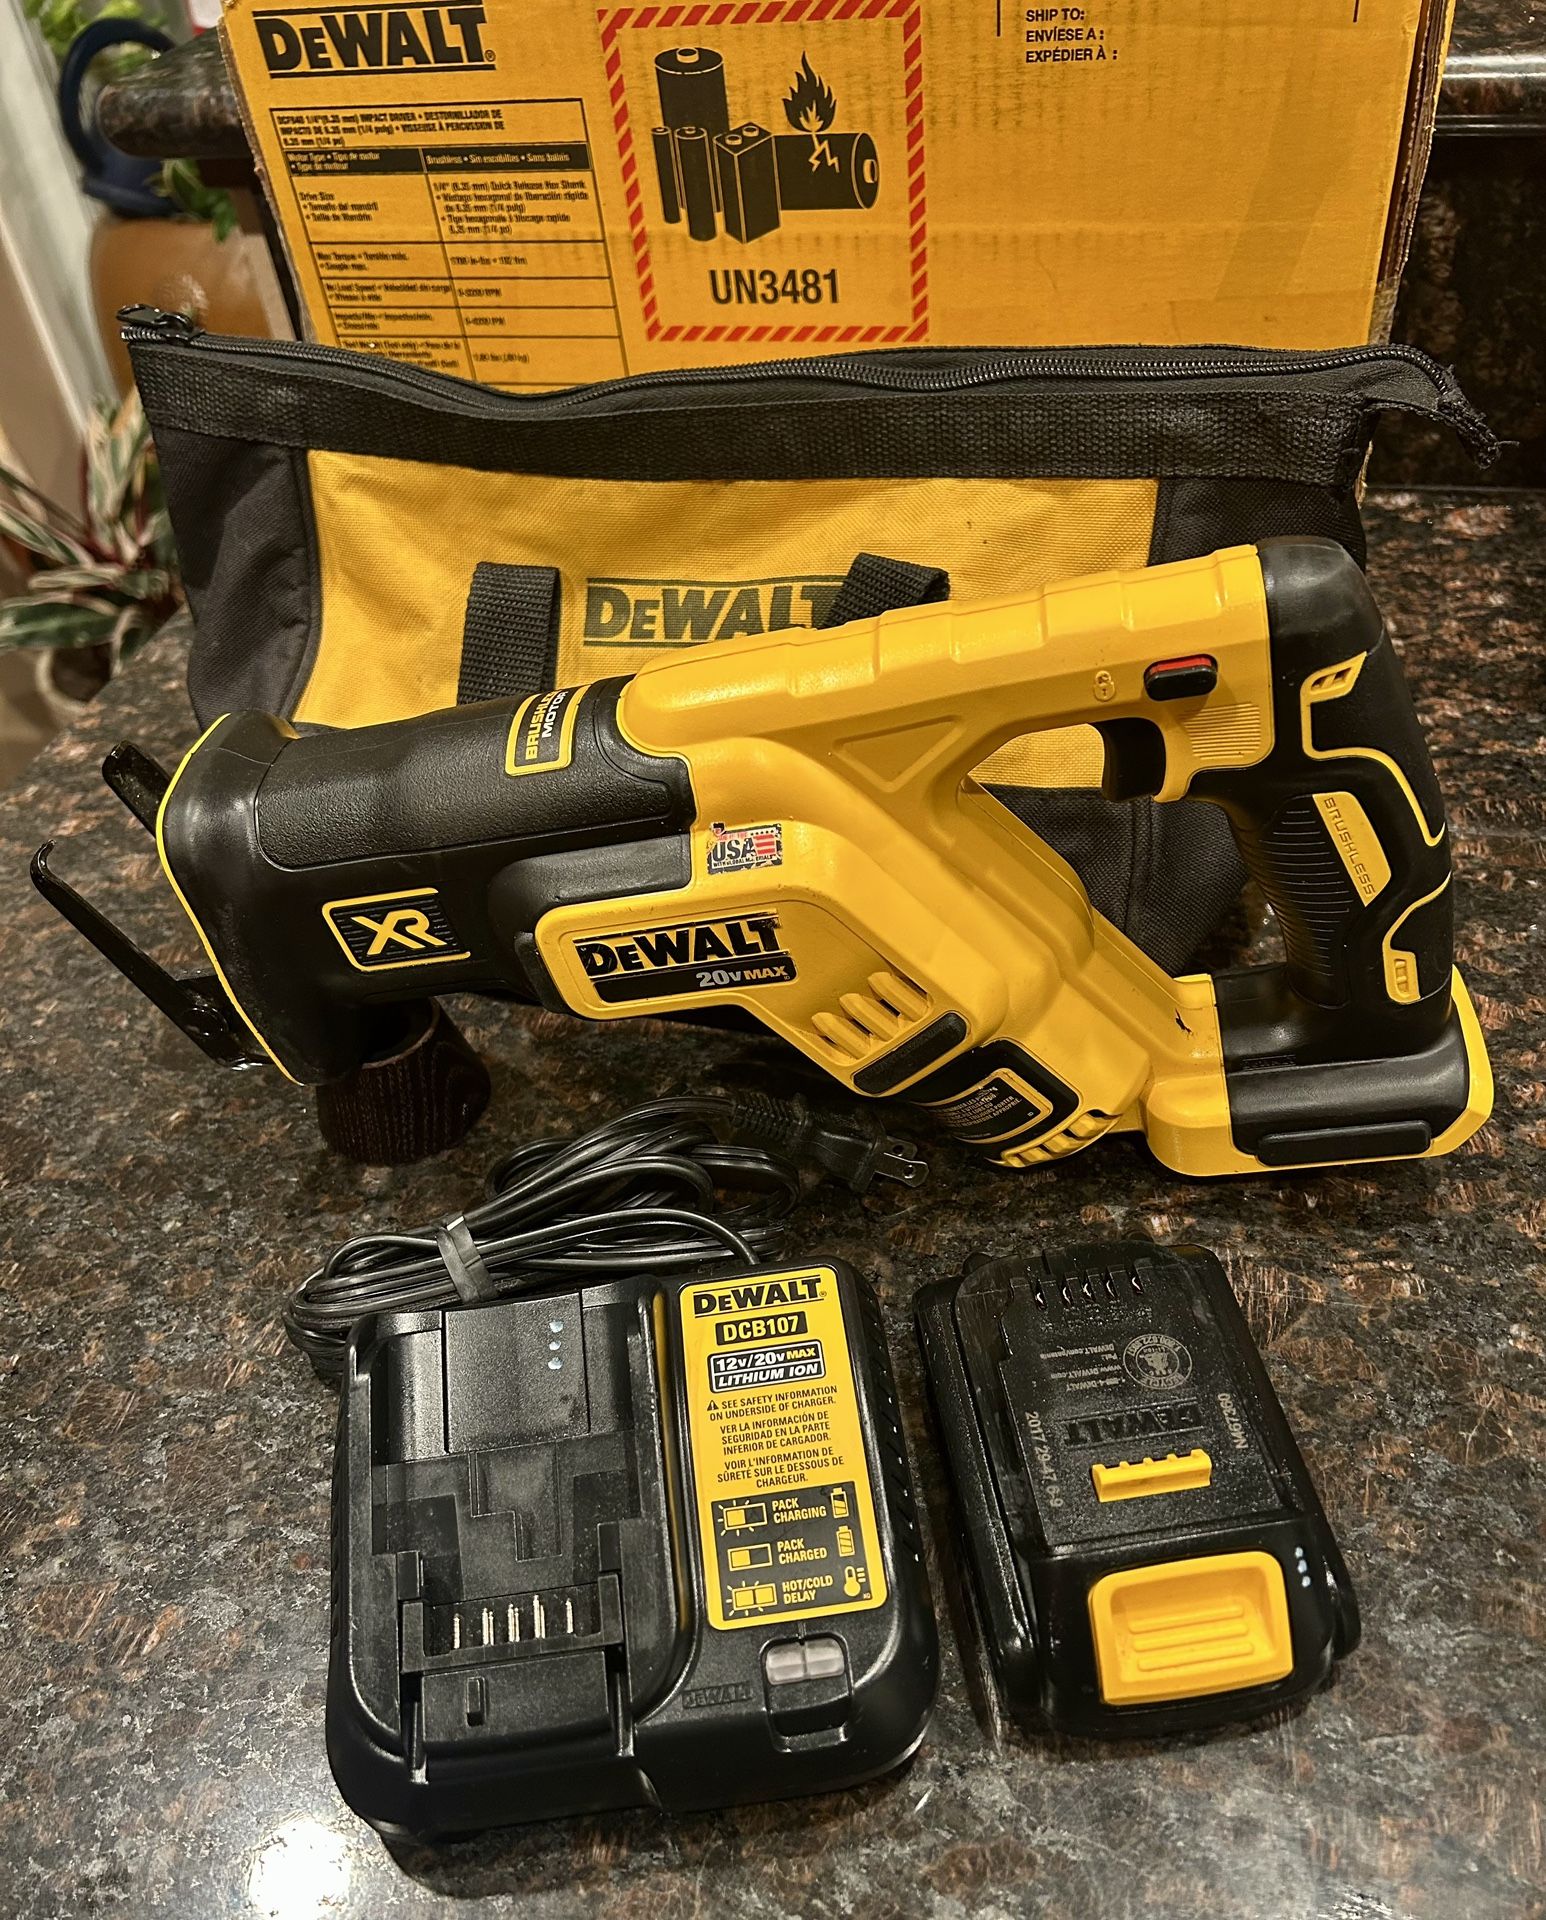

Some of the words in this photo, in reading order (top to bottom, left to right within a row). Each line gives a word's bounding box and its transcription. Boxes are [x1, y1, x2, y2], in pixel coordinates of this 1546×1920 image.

[1026, 9, 1058, 22] SHIP
[1060, 8, 1084, 21] TO:
[1026, 26, 1083, 42] ENVÍESE
[1026, 47, 1092, 63] EXPÉDIER
[709, 269, 839, 304] UN3481
[542, 691, 568, 738] MOTOR
[713, 837, 756, 862] USA
[1324, 797, 1376, 895] BRUSHLESS
[350, 909, 448, 955] XR
[743, 966, 788, 981] MAX
[723, 1315, 799, 1341] DCB107
[719, 1369, 784, 1387] LITHIUM
[789, 1363, 818, 1377] ION
[710, 1412, 723, 1421] ON
[725, 1404, 776, 1419] UNDERSIDE
[780, 1403, 790, 1412] OF
[792, 1396, 836, 1410] CHARGER.
[722, 1400, 738, 1410] SEE
[740, 1395, 773, 1407] SAFETY
[775, 1385, 838, 1401] INFORMATION
[720, 1424, 737, 1434] VER
[739, 1422, 750, 1432] LA
[752, 1412, 815, 1430] INFORMACIÓN
[817, 1411, 829, 1420] DE
[722, 1429, 773, 1445] SEGURIDAD
[775, 1427, 787, 1437] EN
[789, 1425, 800, 1435] LA
[802, 1421, 830, 1433] PARTE
[1024, 1411, 1047, 1443] 2017
[723, 1441, 764, 1456] INFERIOR
[766, 1439, 778, 1449] DE
[780, 1432, 831, 1447] CARGADOR.
[717, 1466, 752, 1483] SÛRETÉ
[754, 1467, 773, 1478] SUR
[774, 1464, 785, 1475] LE
[787, 1458, 830, 1473] DESSOUS
[832, 1455, 844, 1466] DE
[724, 1459, 746, 1470] VOIR
[748, 1448, 819, 1467] L'INFORMATION
[822, 1446, 834, 1456] DE
[756, 1473, 808, 1488] CHARGEUR.
[772, 1498, 799, 1511] PACK
[773, 1506, 826, 1524] CHARGING
[777, 1538, 804, 1552] PACK
[779, 1547, 827, 1564] CHARGED
[782, 1575, 833, 1592] HOT/COLD
[784, 1590, 816, 1604] DELAY
